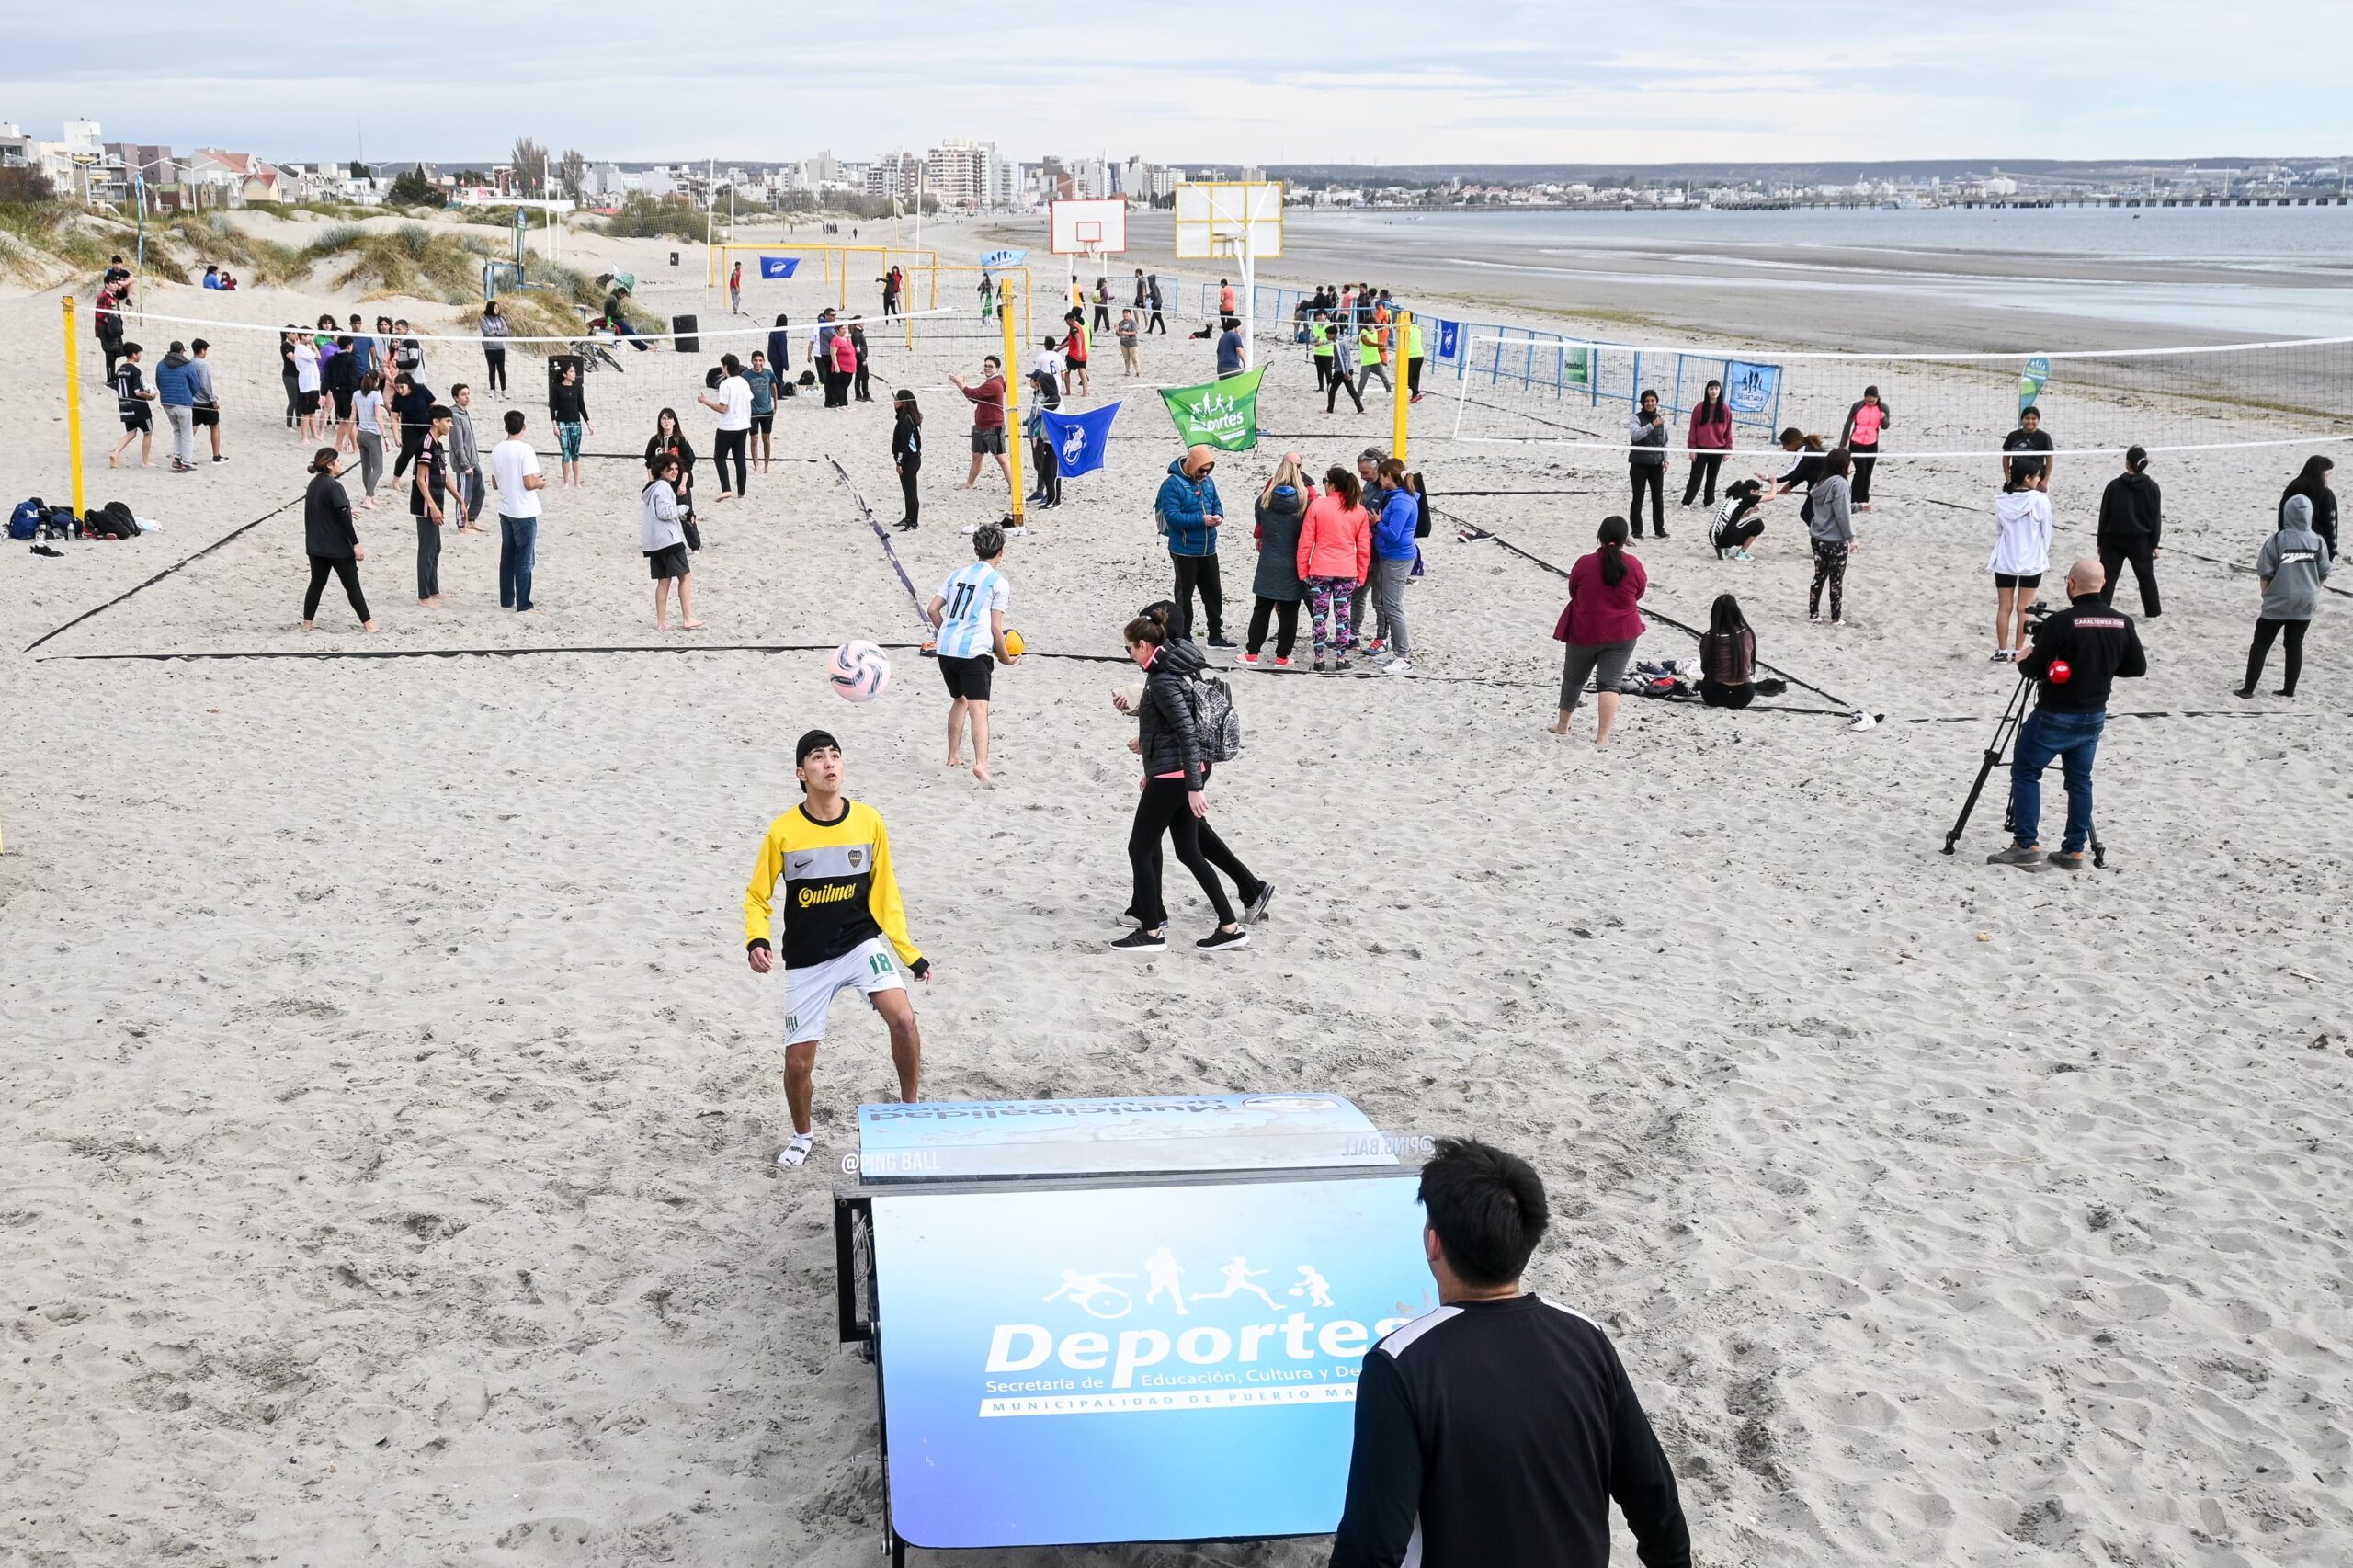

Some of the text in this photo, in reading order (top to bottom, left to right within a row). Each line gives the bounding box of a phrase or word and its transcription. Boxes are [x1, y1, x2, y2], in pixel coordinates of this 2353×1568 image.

[949, 582, 976, 620] 11
[798, 882, 857, 908] Quilmes
[869, 952, 893, 975] 18
[870, 1104, 1229, 1121] Municipalidad
[985, 1366, 1360, 1393] Secretaría de Educación, Cultura y De
[993, 1388, 1353, 1412] MUNICIPALIDAD DE PUERTO MA
